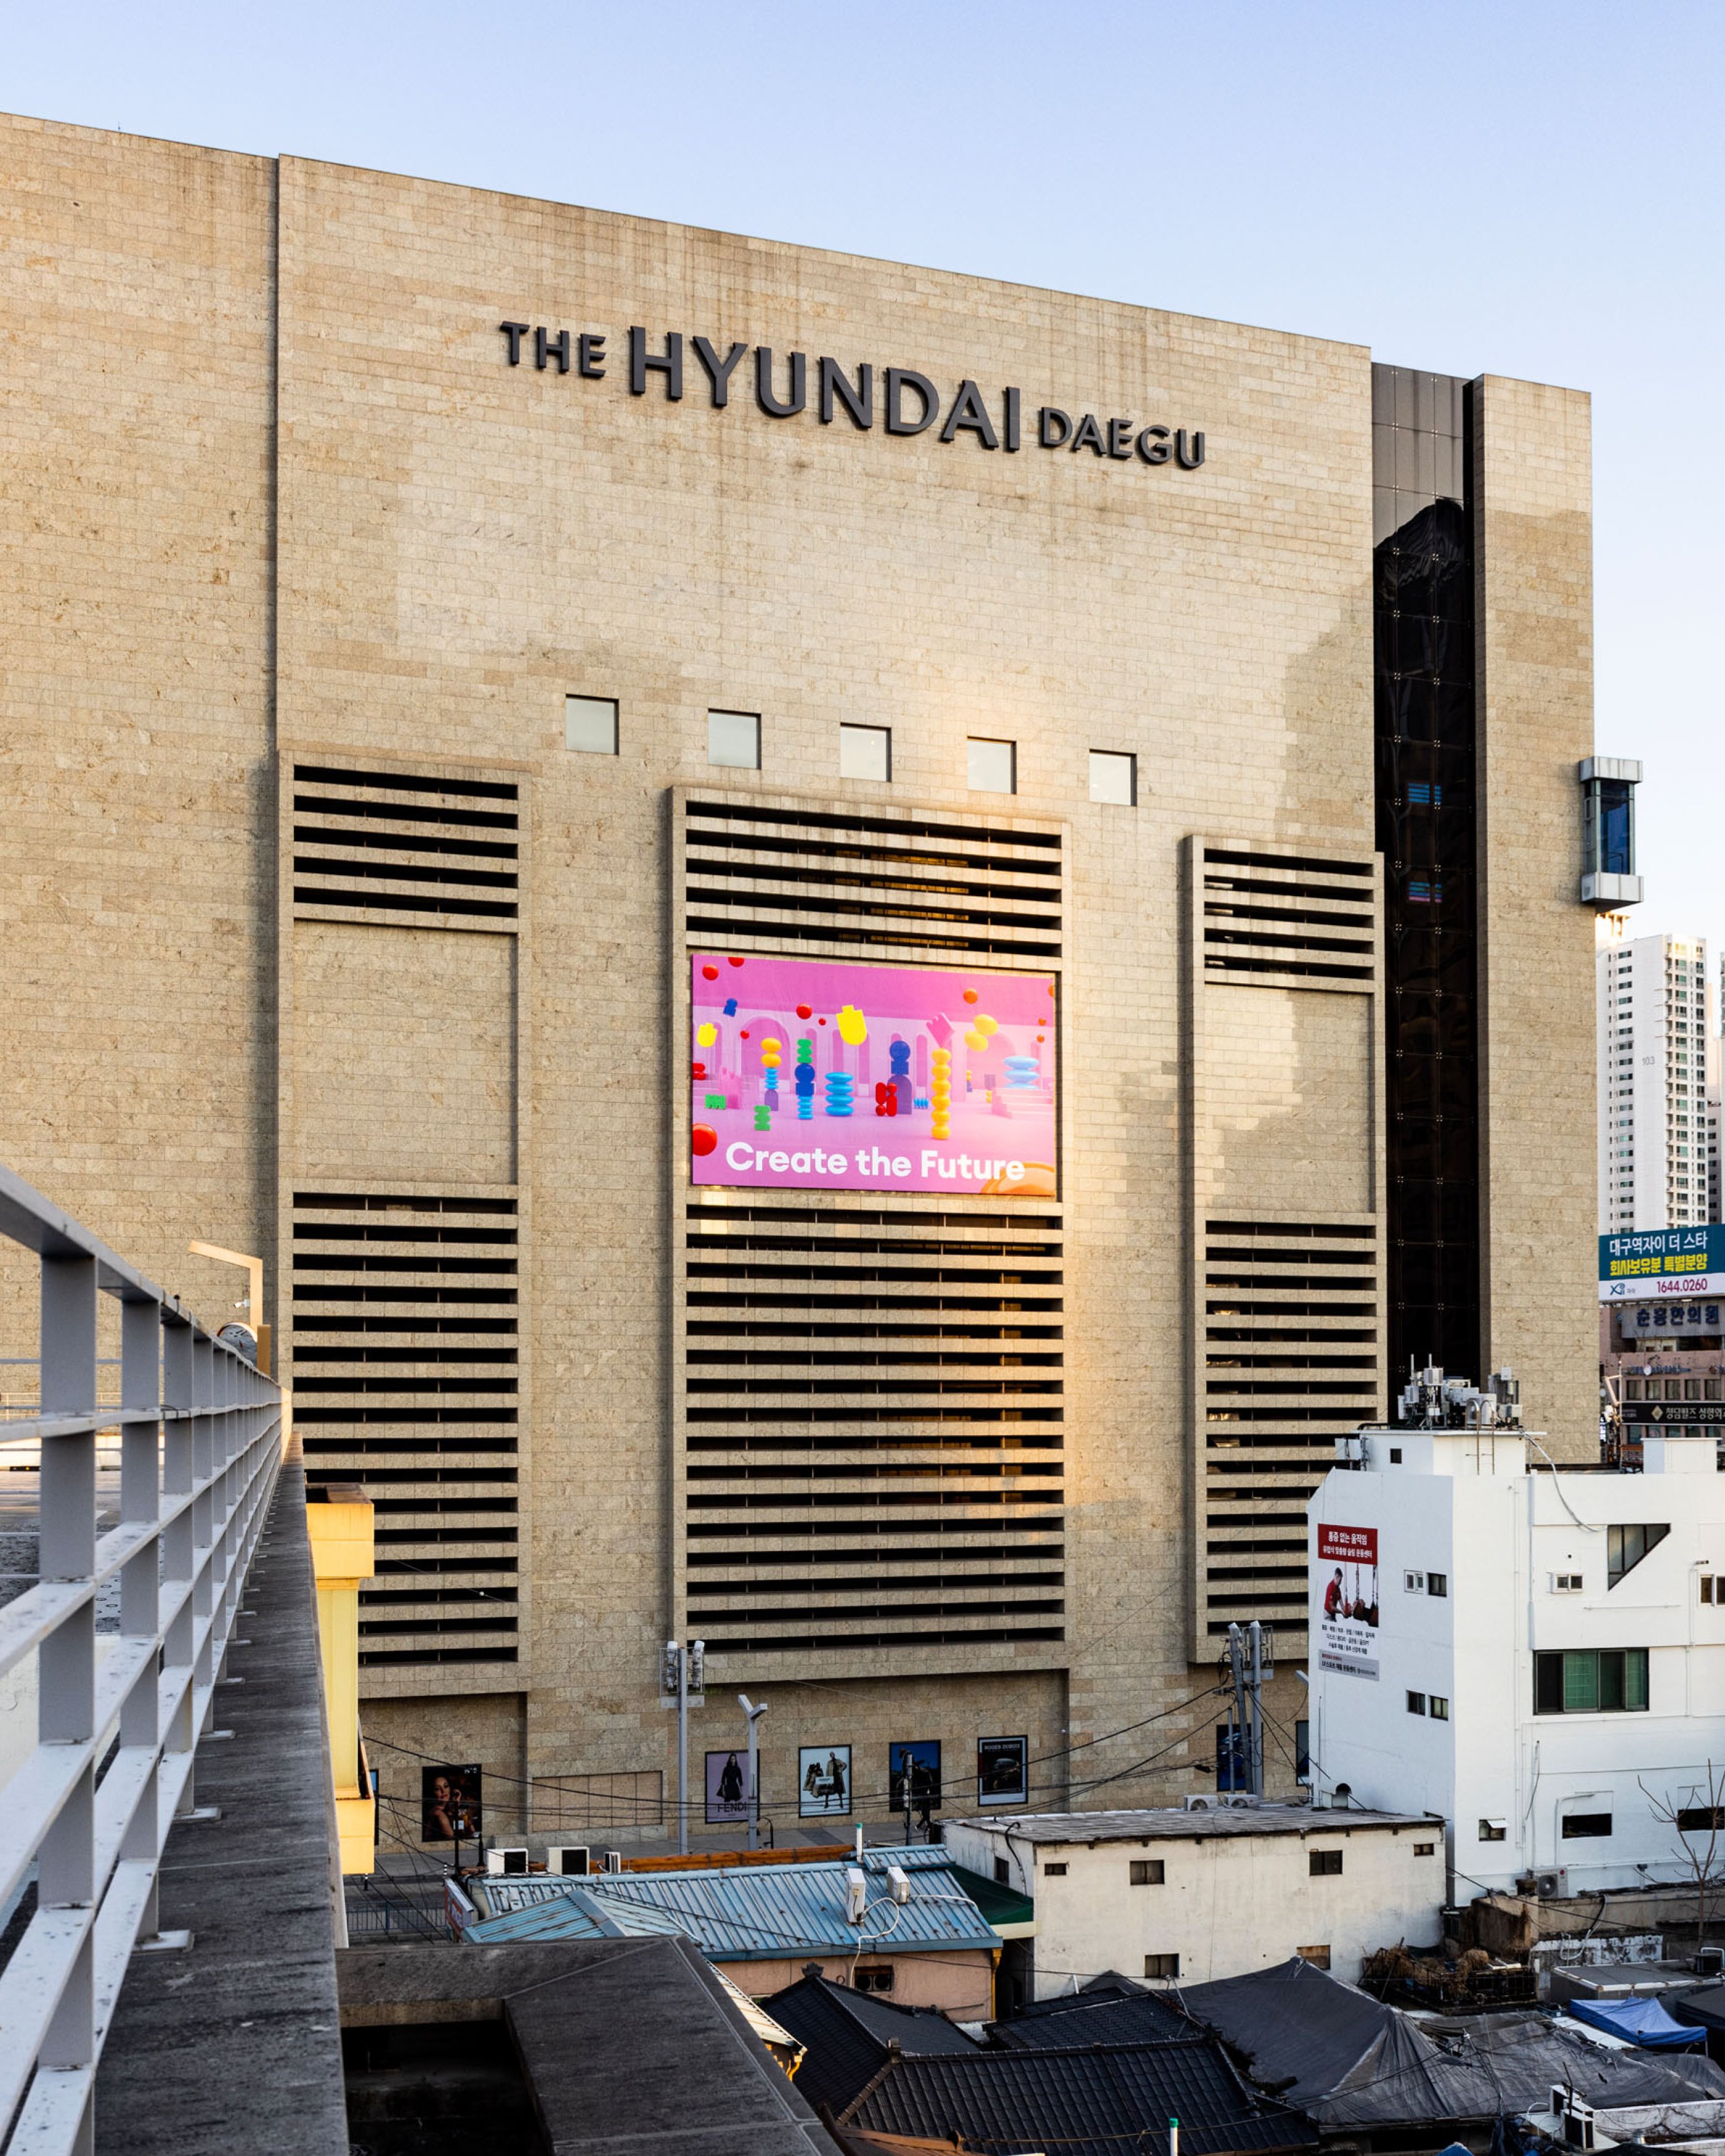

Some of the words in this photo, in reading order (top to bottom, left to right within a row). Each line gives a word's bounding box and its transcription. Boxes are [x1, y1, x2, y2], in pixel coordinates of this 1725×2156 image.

[500, 320, 607, 379] THE
[629, 325, 1021, 452] HYUNDAI
[1040, 406, 1206, 469] DAEGU
[1642, 1056, 1655, 1066] 103
[725, 1141, 848, 1175] Create
[855, 1146, 912, 1178] the
[921, 1149, 1026, 1181] Future
[1609, 1234, 1666, 1257] 대구역자이
[1669, 1233, 1680, 1252] 더
[1682, 1230, 1708, 1250] 스타
[1610, 1256, 1661, 1276] 회사보유분
[1664, 1253, 1708, 1273] 특별분양
[1657, 1278, 1708, 1293] 1644.0260
[718, 1802, 747, 1813] FENDI
